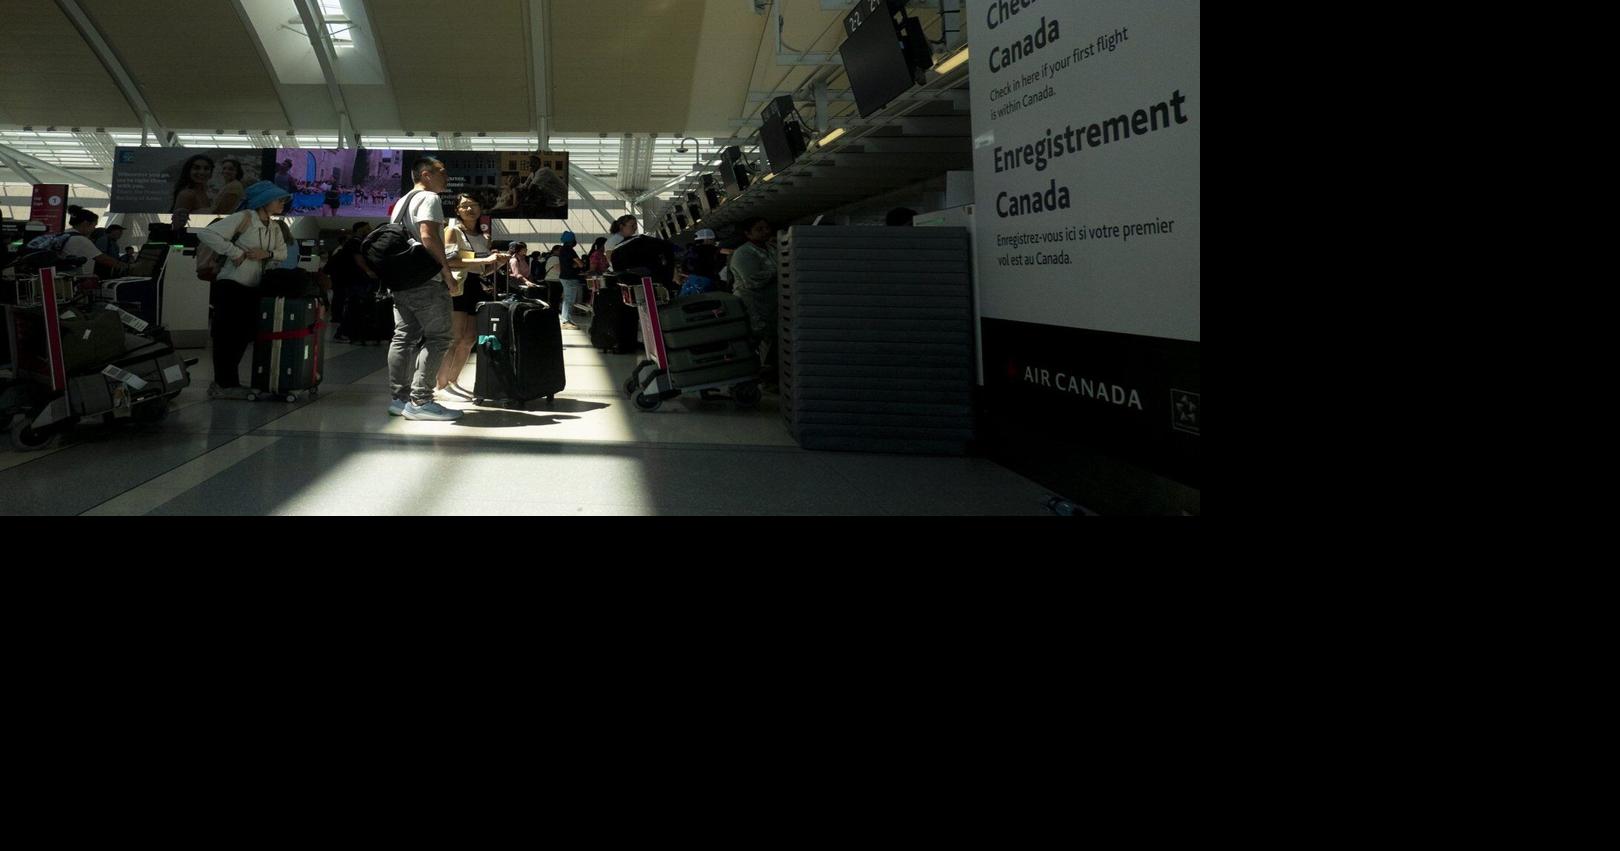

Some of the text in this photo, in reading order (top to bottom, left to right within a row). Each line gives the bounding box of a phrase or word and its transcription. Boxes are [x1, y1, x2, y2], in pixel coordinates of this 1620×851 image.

[989, 16, 1060, 73] Canada
[990, 27, 1129, 102] Check in here if your first flight
[990, 84, 1056, 121] is within Canada.
[993, 89, 1189, 173] Enregistrement
[996, 179, 1071, 218] Canada
[997, 217, 1175, 249] Enregistrez-vous ici si votre premier
[998, 250, 1073, 266] vol est au Canada.
[1023, 365, 1144, 411] AIR CANADA
